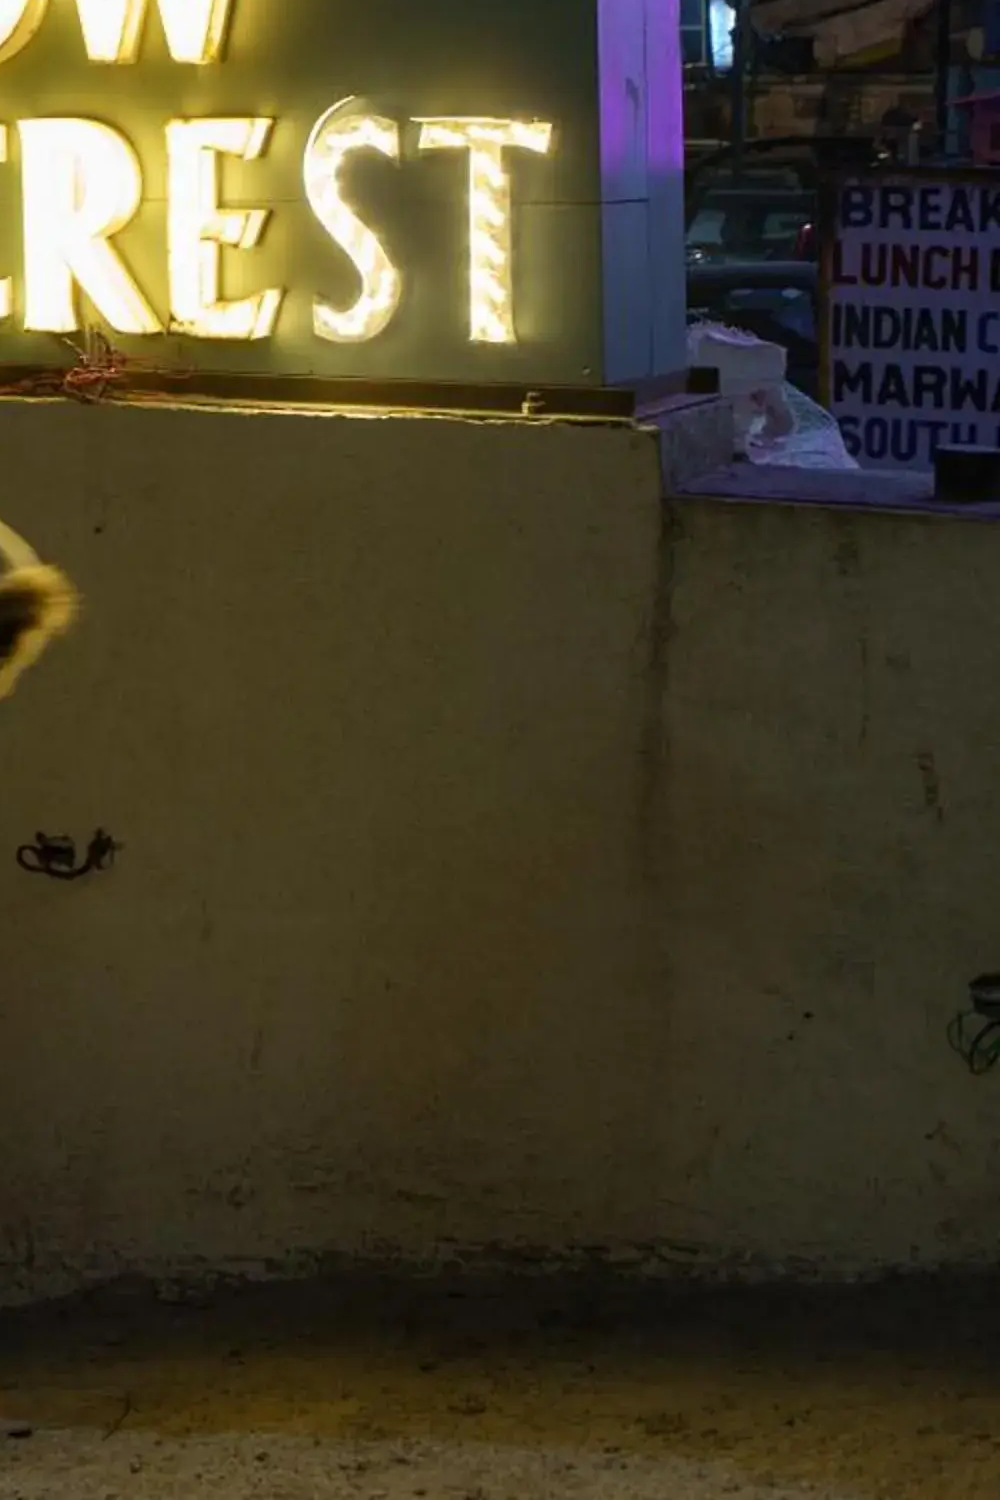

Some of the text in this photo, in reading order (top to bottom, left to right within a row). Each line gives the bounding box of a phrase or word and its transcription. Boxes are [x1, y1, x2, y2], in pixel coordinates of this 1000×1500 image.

[841, 185, 1000, 232] BREAK
[832, 241, 978, 291] LUNCH
[832, 304, 966, 353] INDIAN
